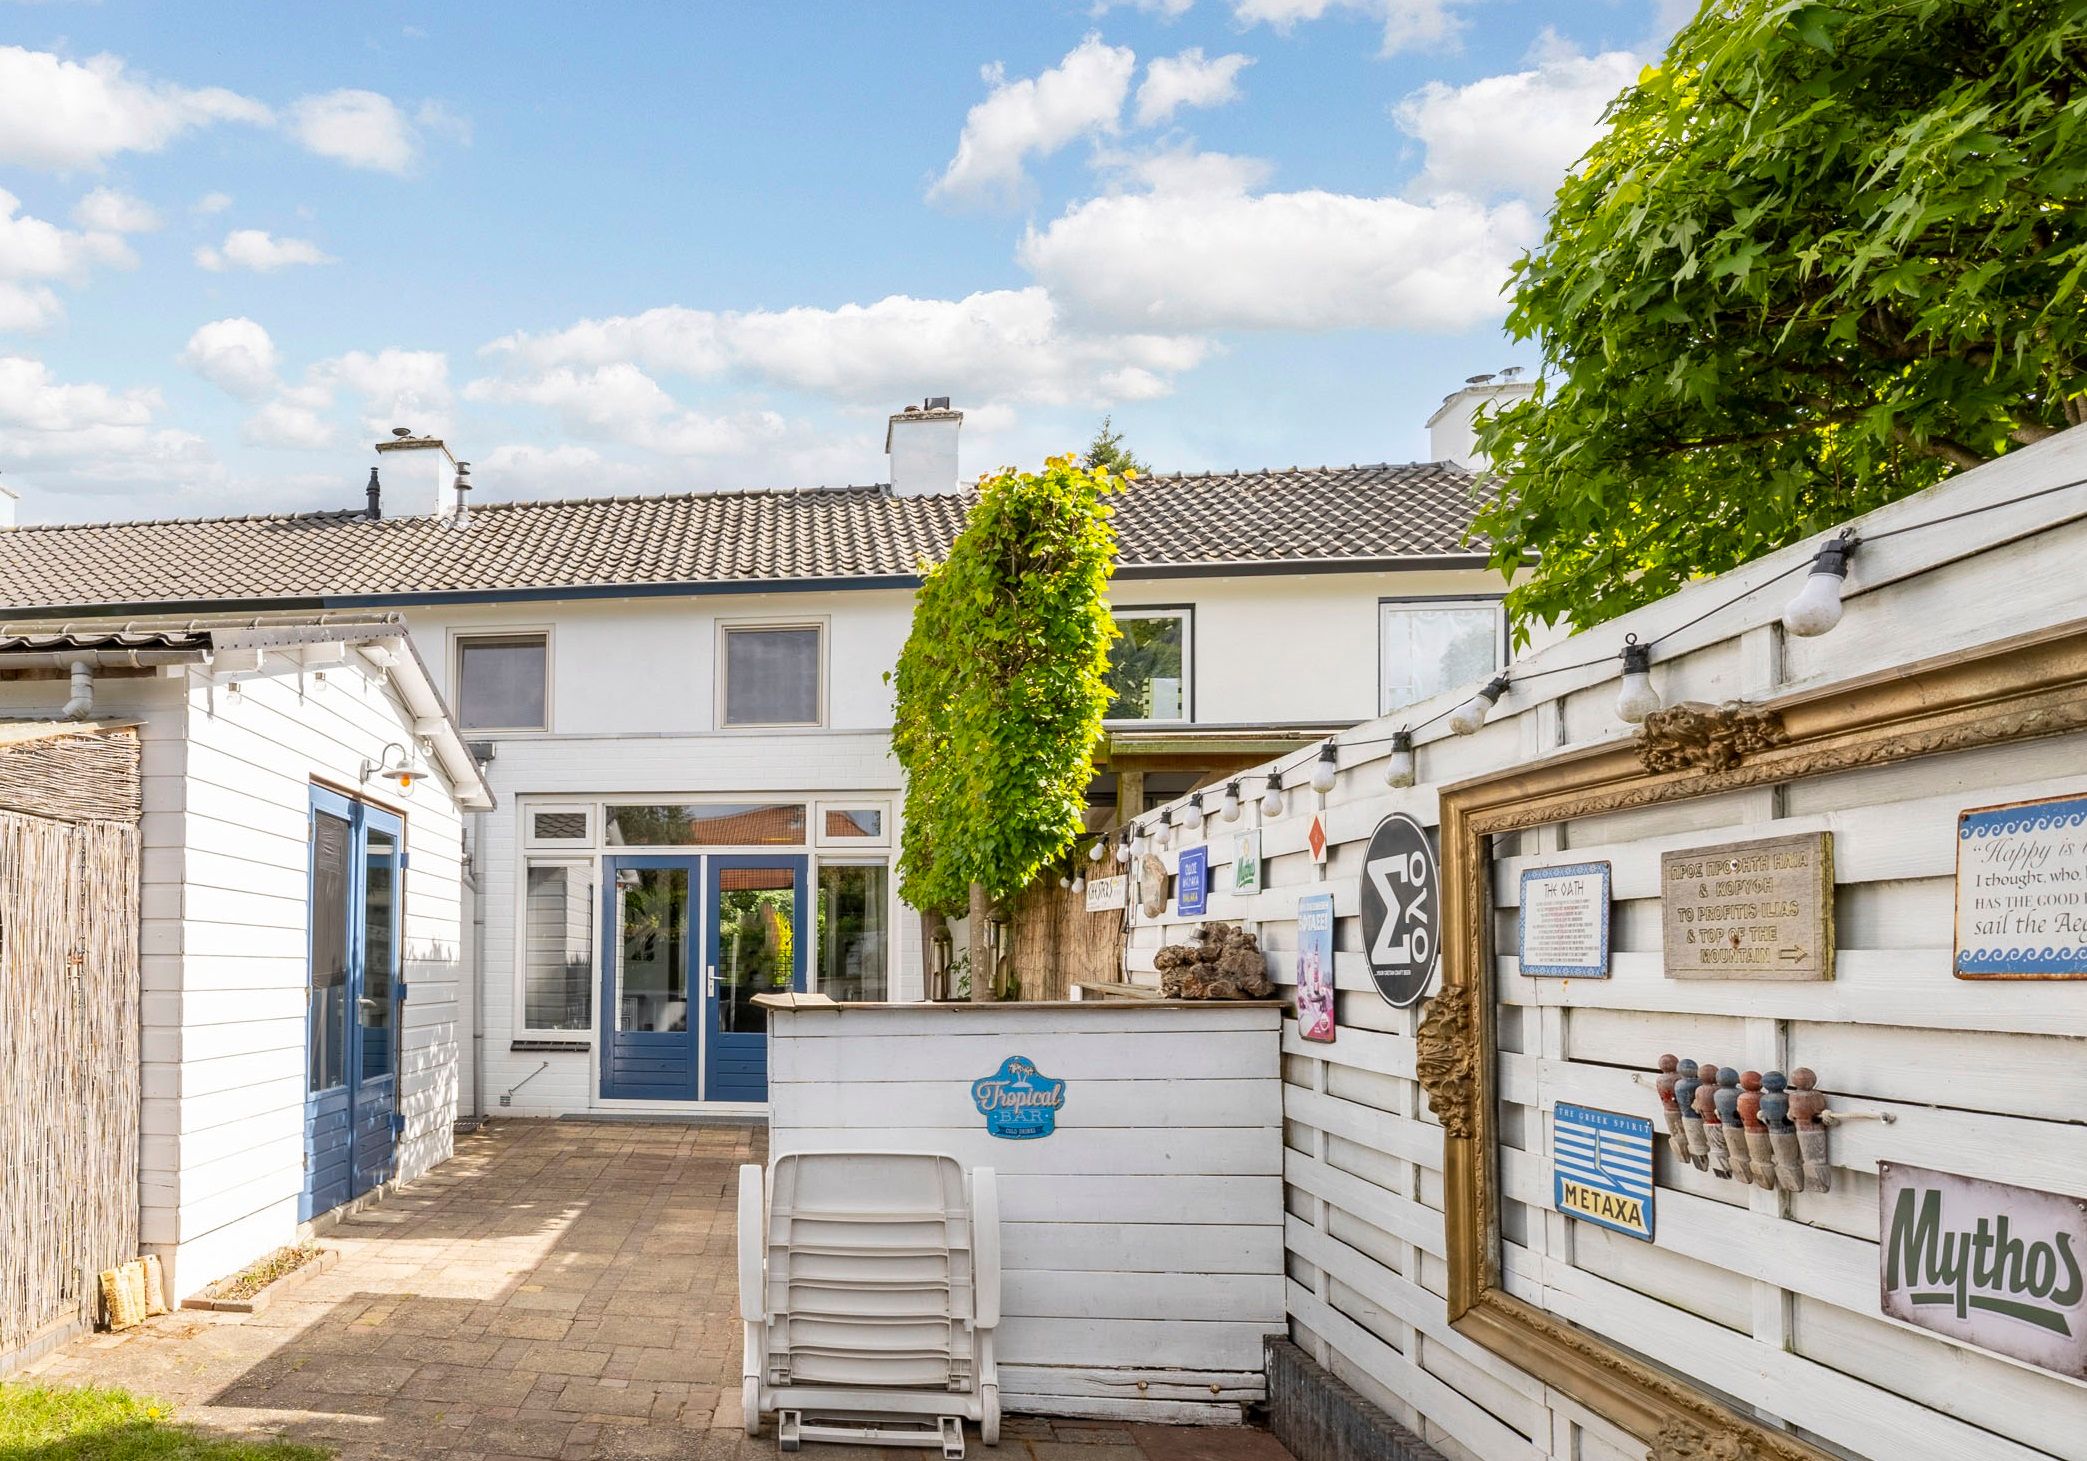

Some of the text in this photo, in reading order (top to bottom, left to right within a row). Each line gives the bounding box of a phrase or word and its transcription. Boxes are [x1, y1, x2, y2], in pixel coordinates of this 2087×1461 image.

[2058, 837, 2075, 857] is
[1670, 862, 1703, 880] ΠΡΟΣ
[1975, 874, 1982, 888] I
[1698, 877, 1774, 898] & ΚΟΡΥΦΗ
[1677, 900, 1800, 922] TO PROFITIS ILIAS
[1975, 897, 2001, 910] HAS
[2004, 894, 2034, 908] THE
[2037, 892, 2079, 906] GOOD
[1973, 909, 2015, 936] sail
[2015, 908, 2047, 935] the
[1686, 925, 1778, 943] & TOP OF THE
[1700, 947, 1771, 964] MOUNTAIN
[976, 1080, 1061, 1115] Tropical
[1000, 1109, 1044, 1122] BAR
[1559, 1107, 1650, 1134] THE GREEK SPIRIT
[1564, 1183, 1643, 1227] METAXA
[1886, 1187, 2084, 1319] Mythos
